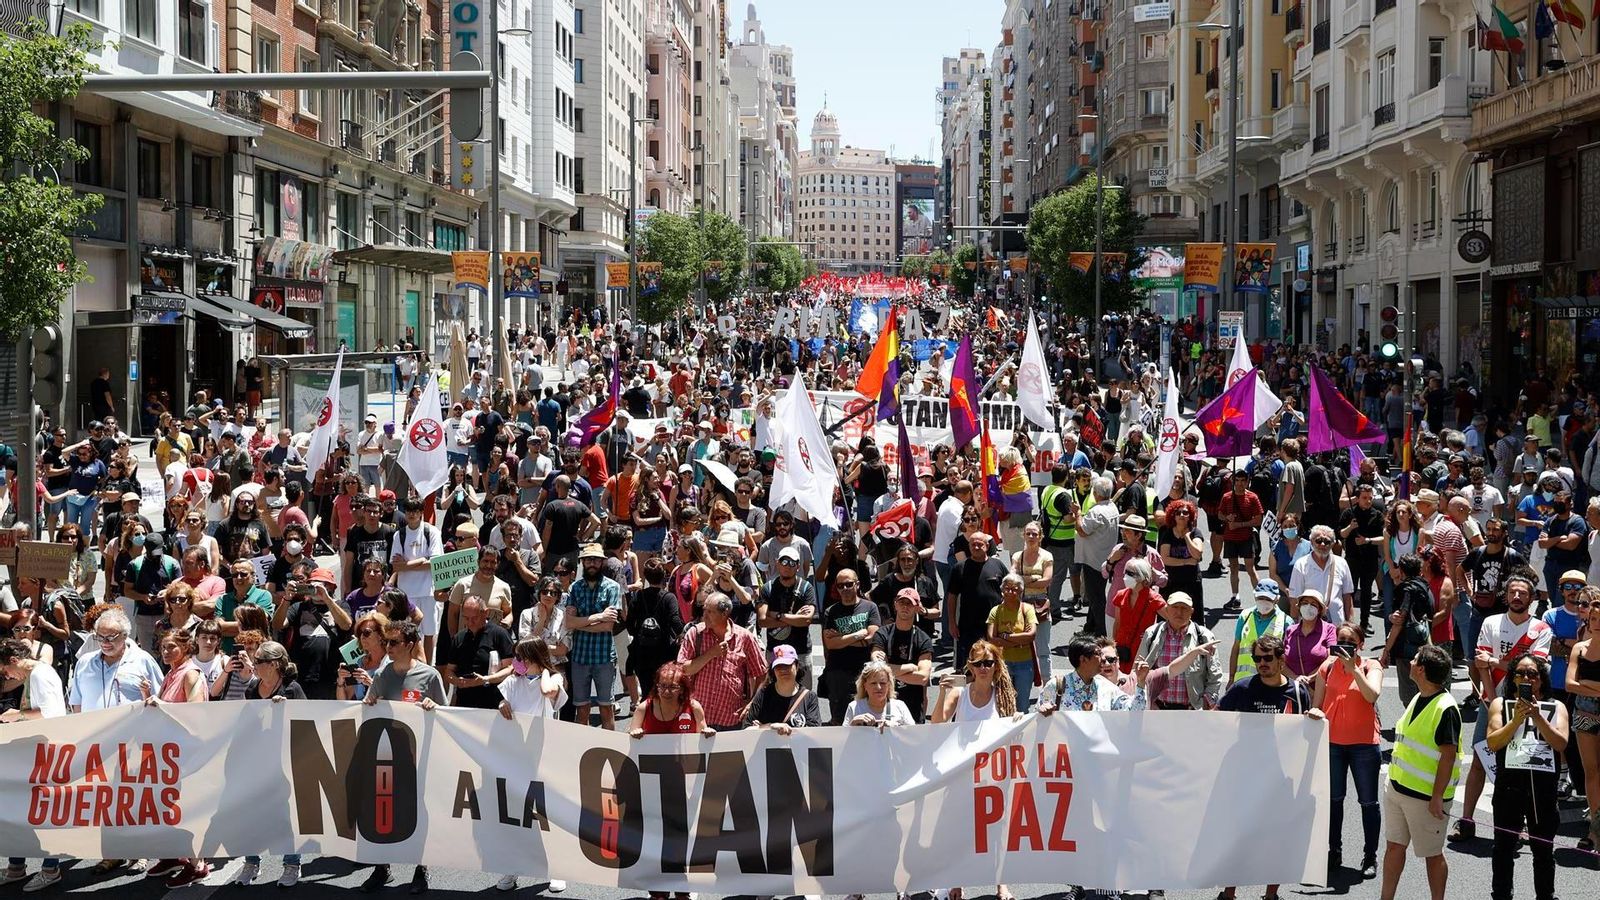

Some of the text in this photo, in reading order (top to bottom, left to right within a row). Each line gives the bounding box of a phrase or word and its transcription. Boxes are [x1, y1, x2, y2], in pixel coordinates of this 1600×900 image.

[433, 555, 475, 571] DIALOGUE
[435, 571, 451, 582] FOR
[29, 742, 181, 784] NO A LAS
[973, 742, 1074, 784] POR LA
[27, 785, 182, 827] GUERRAS
[290, 717, 834, 877] NO A LA OTAN
[973, 781, 1078, 854] PAZ
